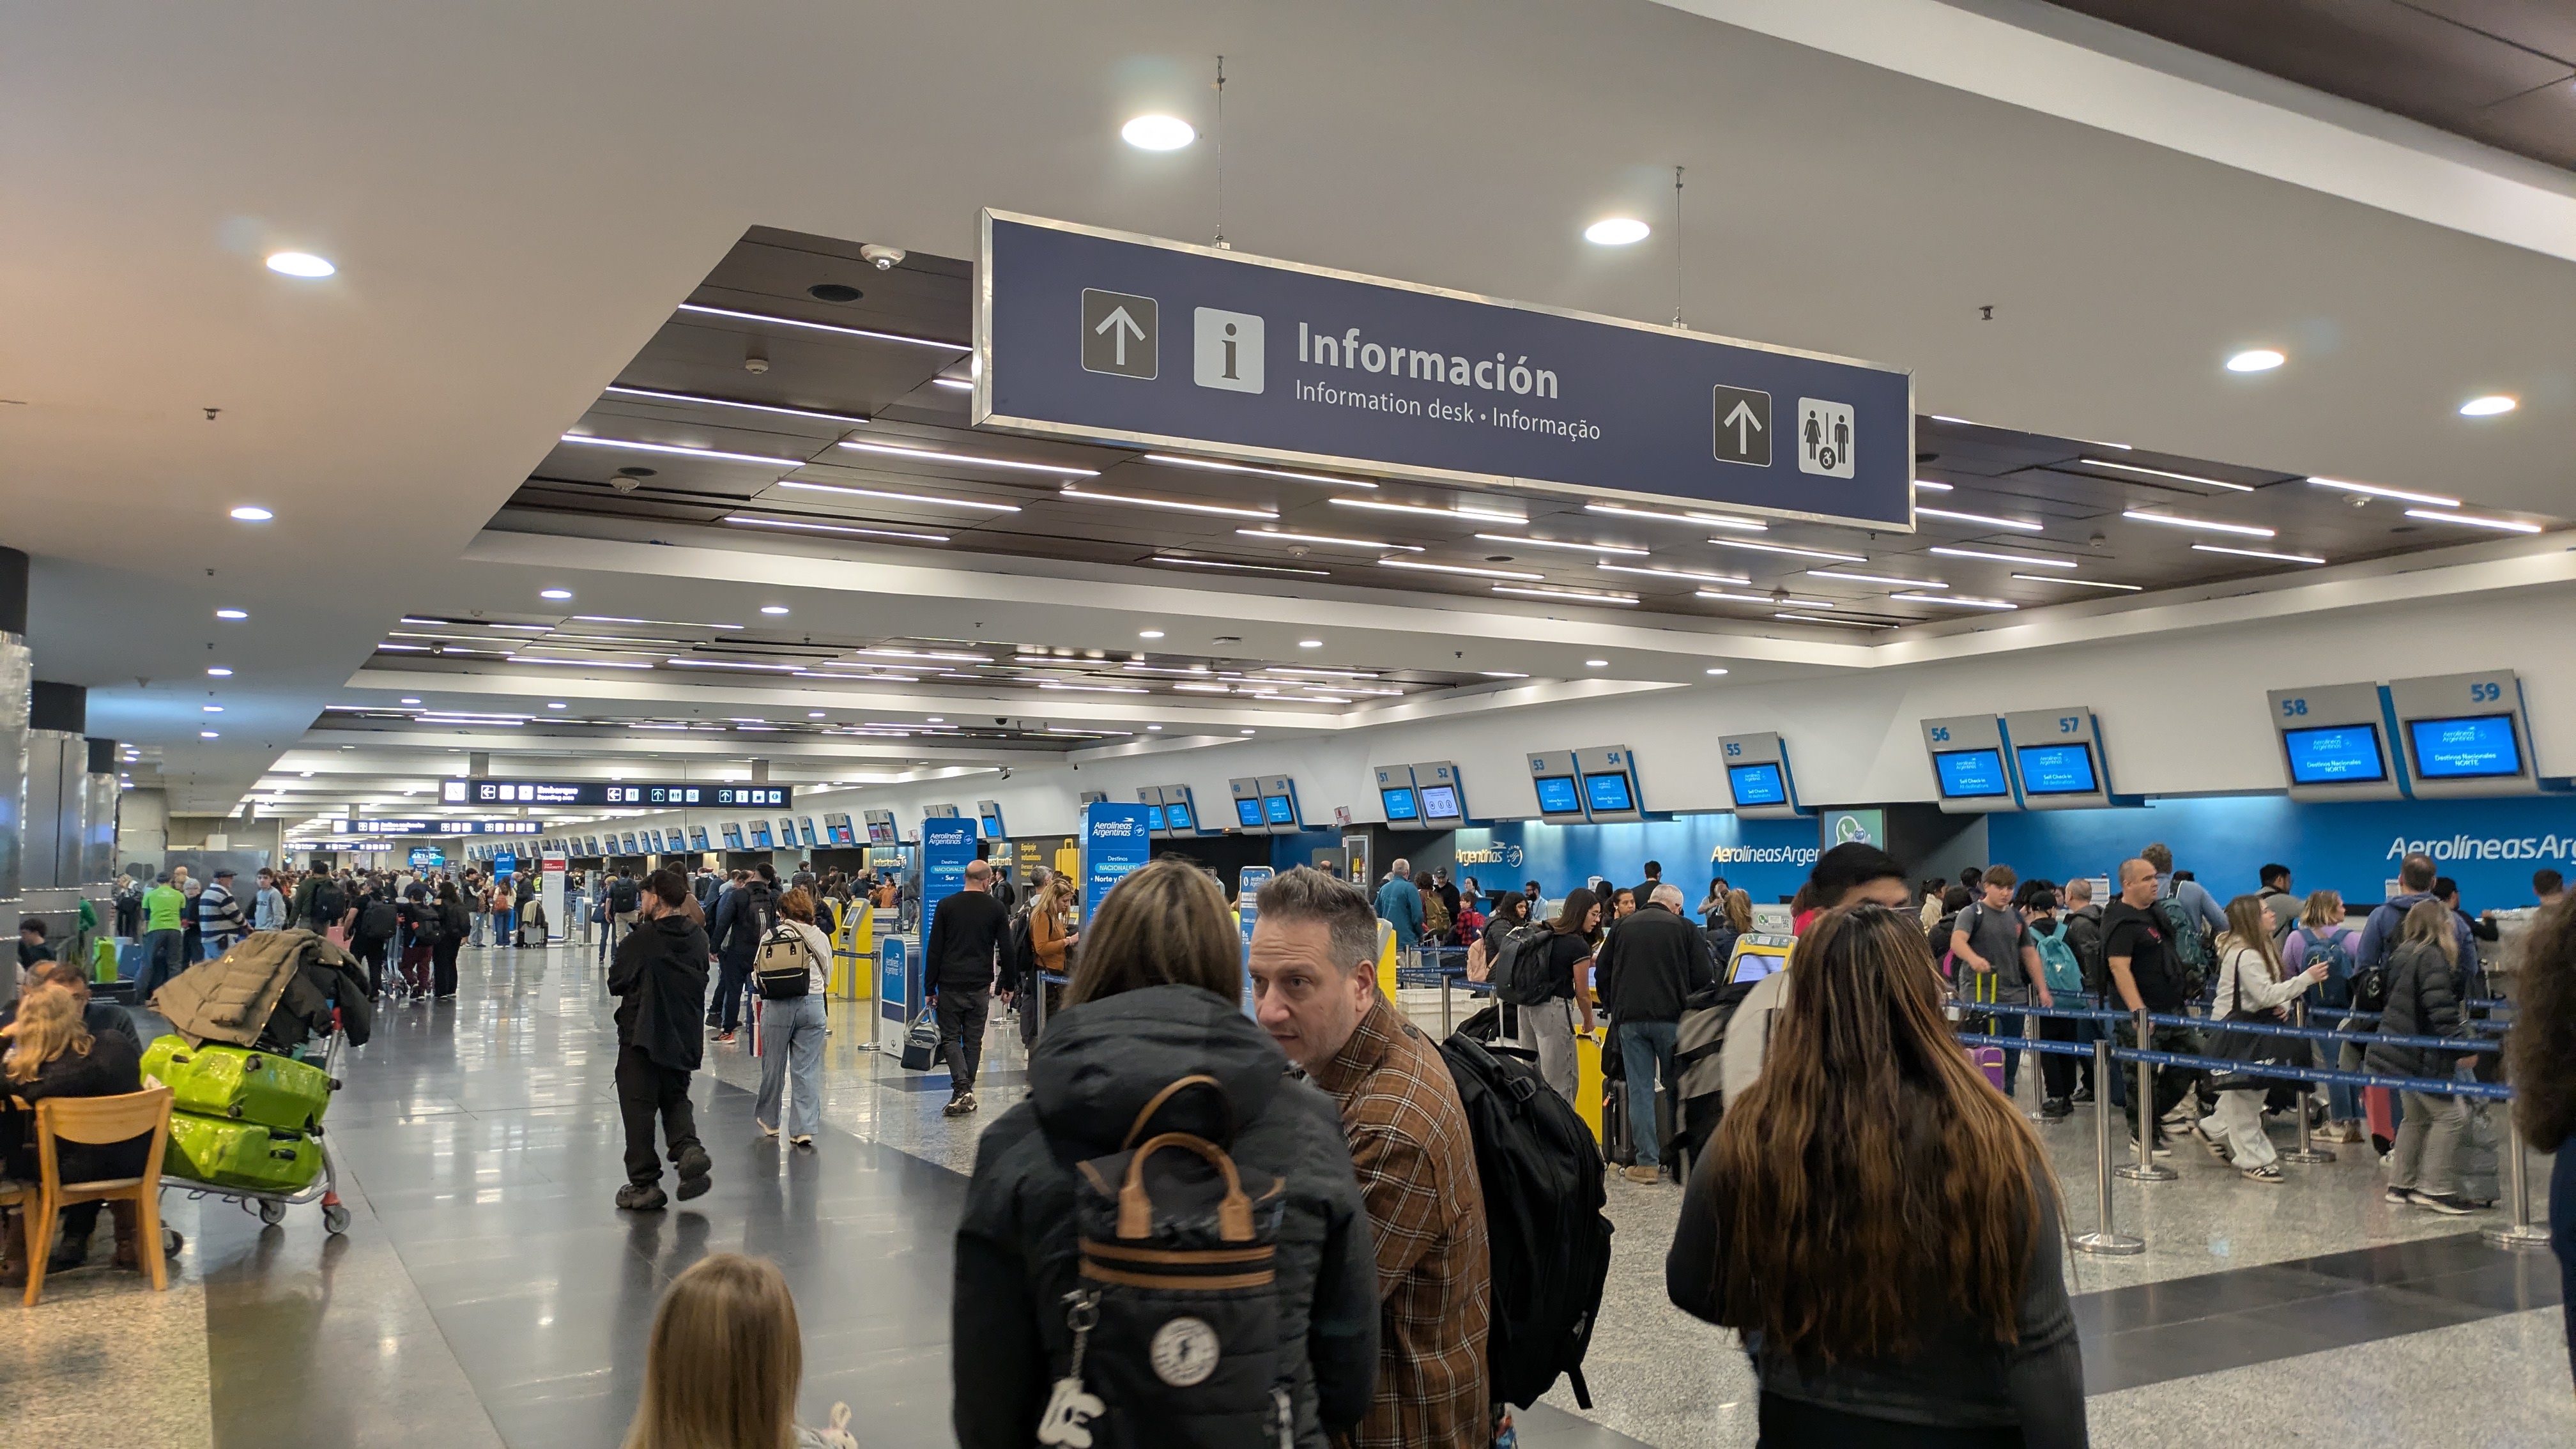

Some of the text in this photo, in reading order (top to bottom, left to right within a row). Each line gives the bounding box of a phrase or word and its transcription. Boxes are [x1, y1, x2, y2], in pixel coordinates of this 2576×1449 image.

[1299, 321, 1558, 399] Información
[1296, 379, 1600, 442] Information desk Informação
[2471, 682, 2501, 702] 59
[2281, 699, 2308, 717] 58
[2059, 717, 2079, 733] 57
[1931, 726, 1951, 742] 56
[1726, 742, 1742, 756] 55
[1533, 759, 1545, 770] 53
[1607, 752, 1620, 765] 54
[1379, 771, 1388, 782] 51
[1437, 767, 1449, 778] 52
[1092, 829, 1131, 838] Argentinas
[1094, 822, 1132, 830] Aerolíneas
[1455, 848, 1503, 866] Argentinas
